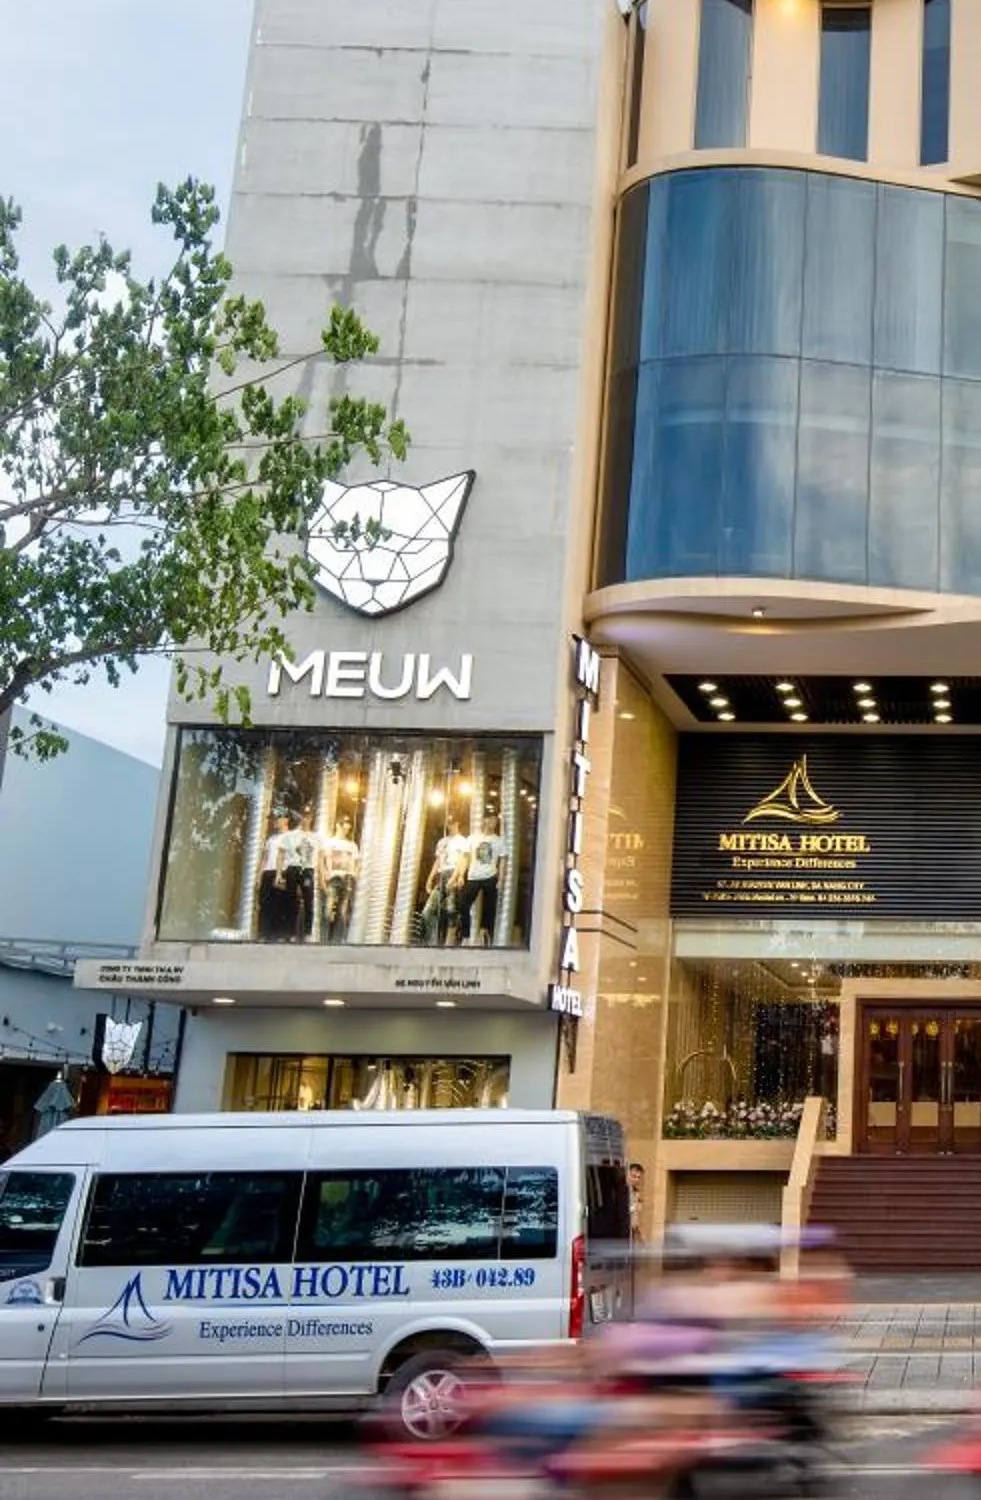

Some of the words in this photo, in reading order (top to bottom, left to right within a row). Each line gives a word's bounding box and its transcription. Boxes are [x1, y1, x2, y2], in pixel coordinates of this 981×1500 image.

[267, 650, 473, 700] MEUW
[560, 638, 600, 973] MITISA
[719, 833, 793, 851] MITISA
[799, 835, 871, 852] HOTEL
[795, 857, 856, 868] Differences
[552, 985, 583, 1017] HOTEL
[163, 1267, 283, 1300] MITISA
[291, 1265, 411, 1298] HOTEL
[200, 1321, 283, 1342] Experience
[287, 1319, 374, 1337] Differences
